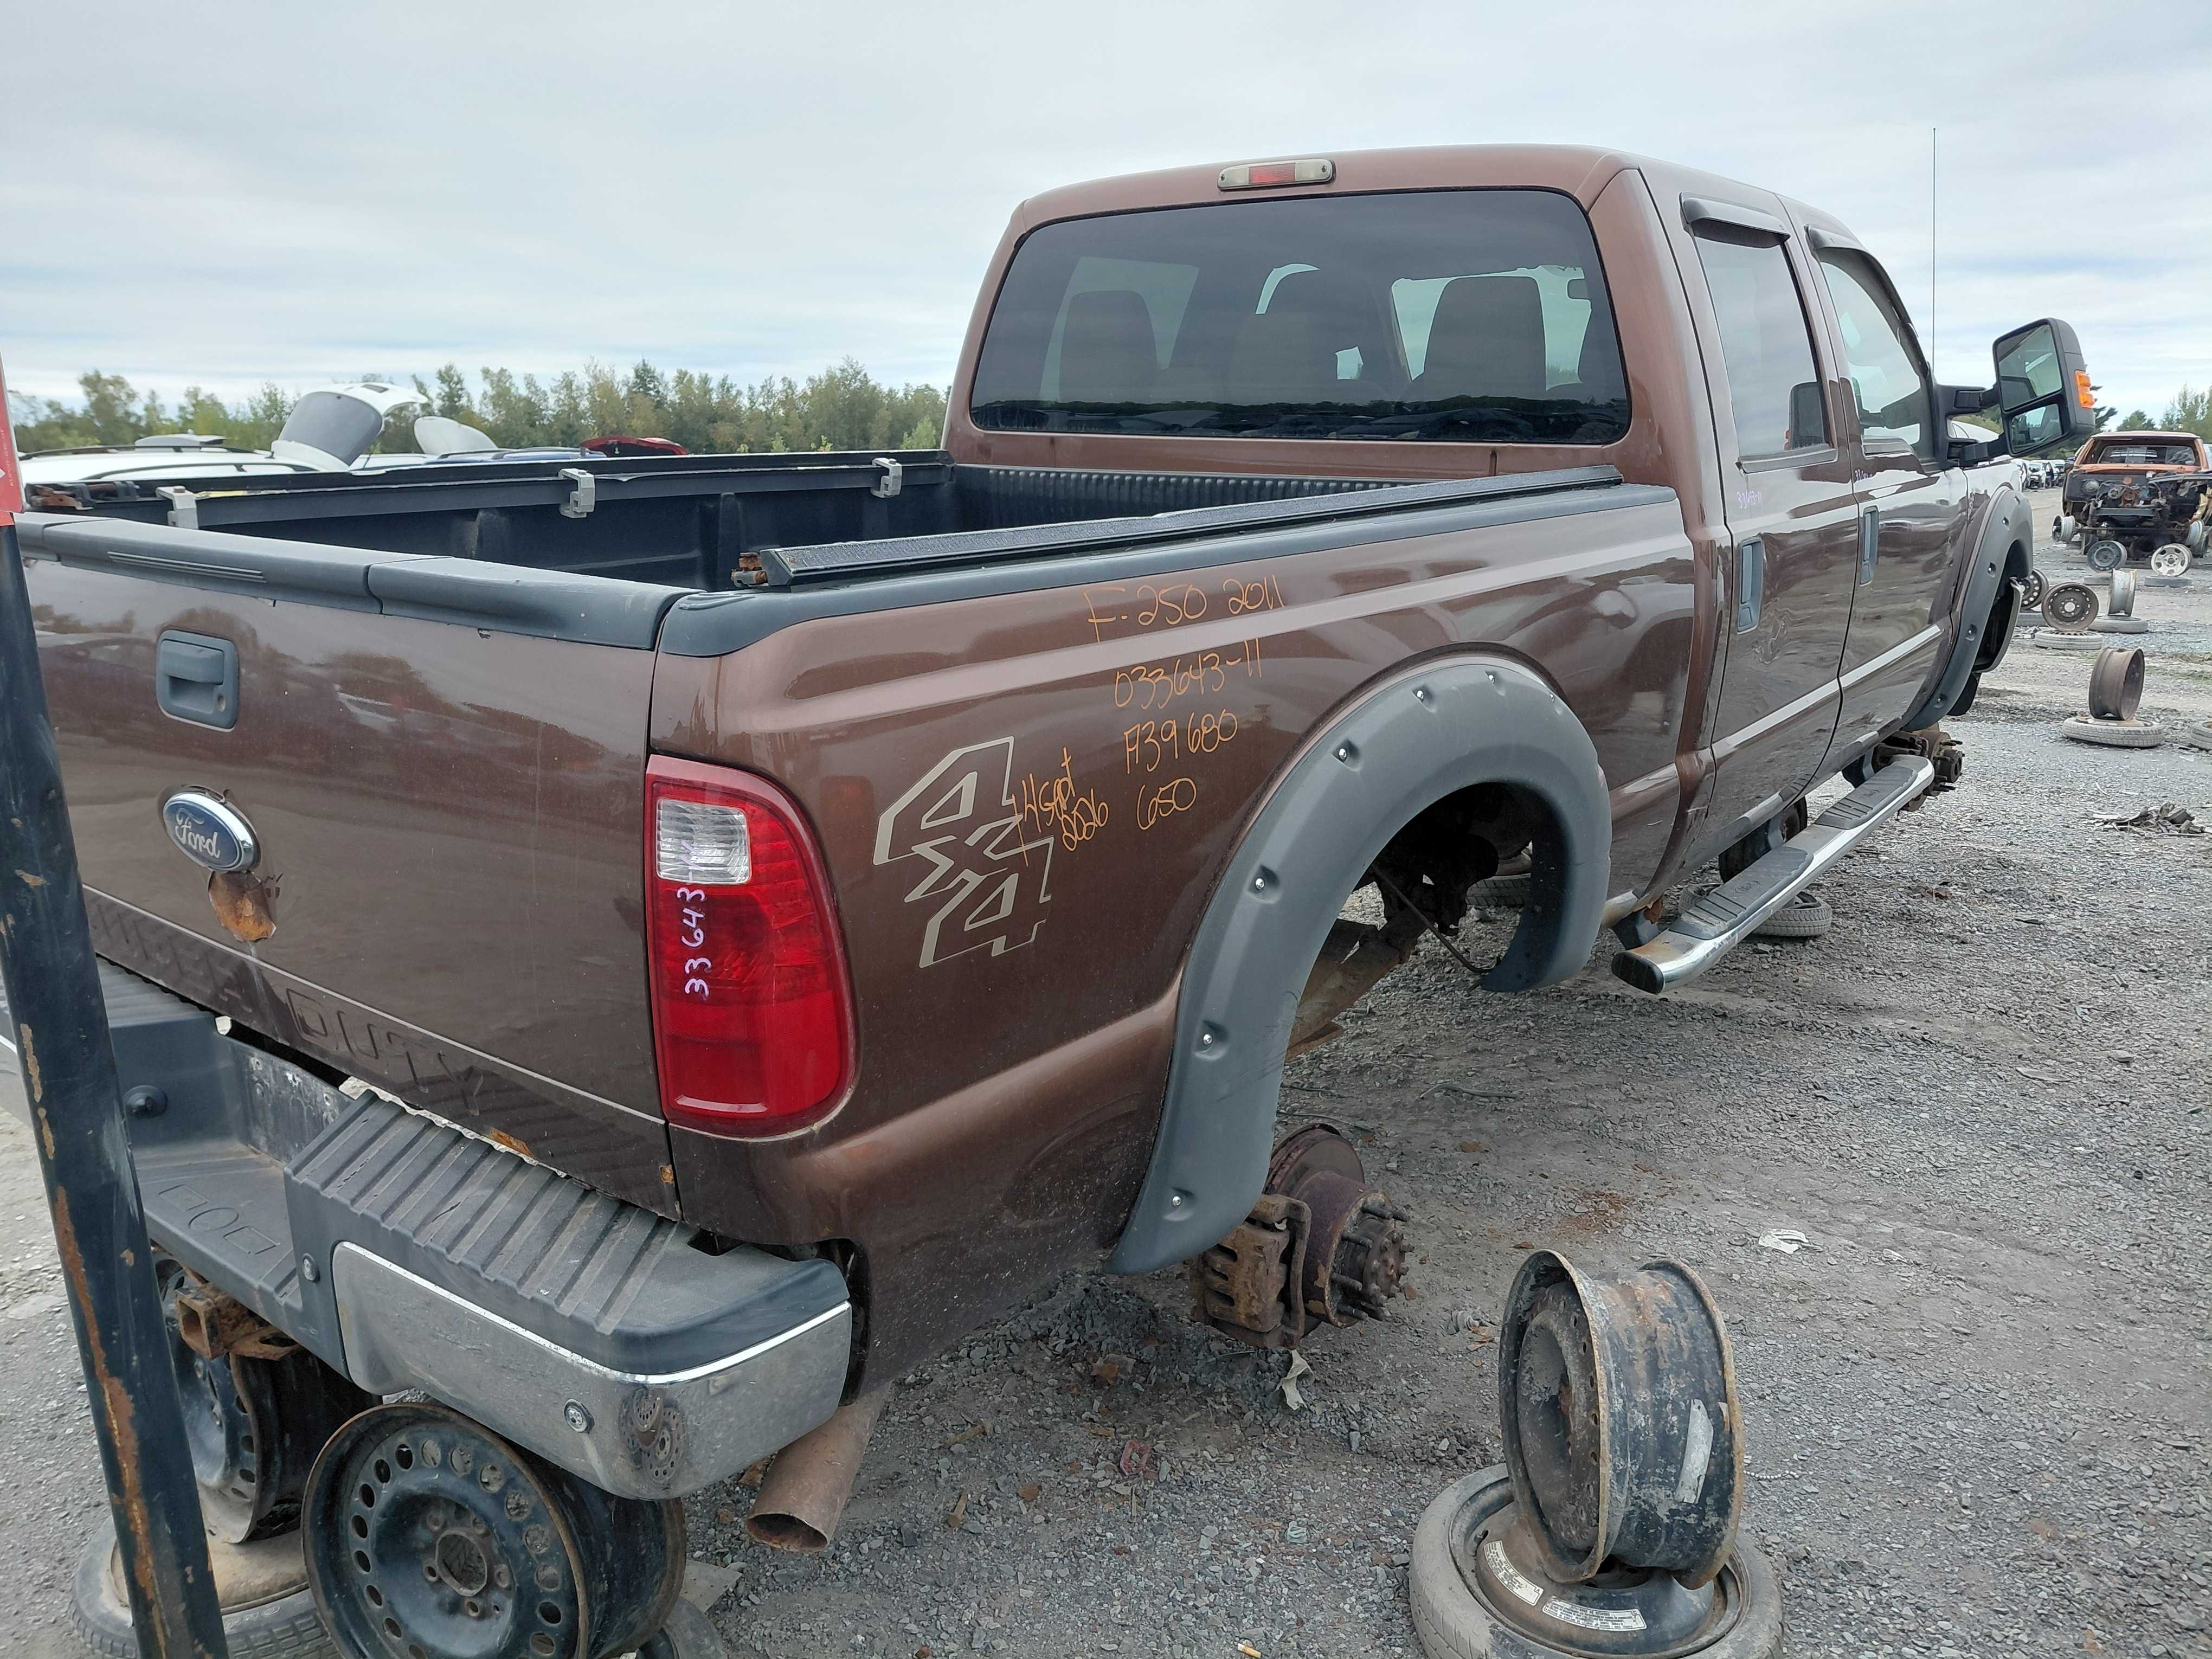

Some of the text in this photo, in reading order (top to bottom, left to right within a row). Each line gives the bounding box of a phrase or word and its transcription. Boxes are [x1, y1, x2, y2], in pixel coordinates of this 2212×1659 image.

[1083, 574, 1285, 643] F-250 2011
[1114, 637, 1263, 710] 033643-11
[1123, 708, 1238, 774] A39680
[174, 807, 221, 859] Ford
[1136, 777, 1197, 831] 650
[285, 987, 485, 1117] DUTY
